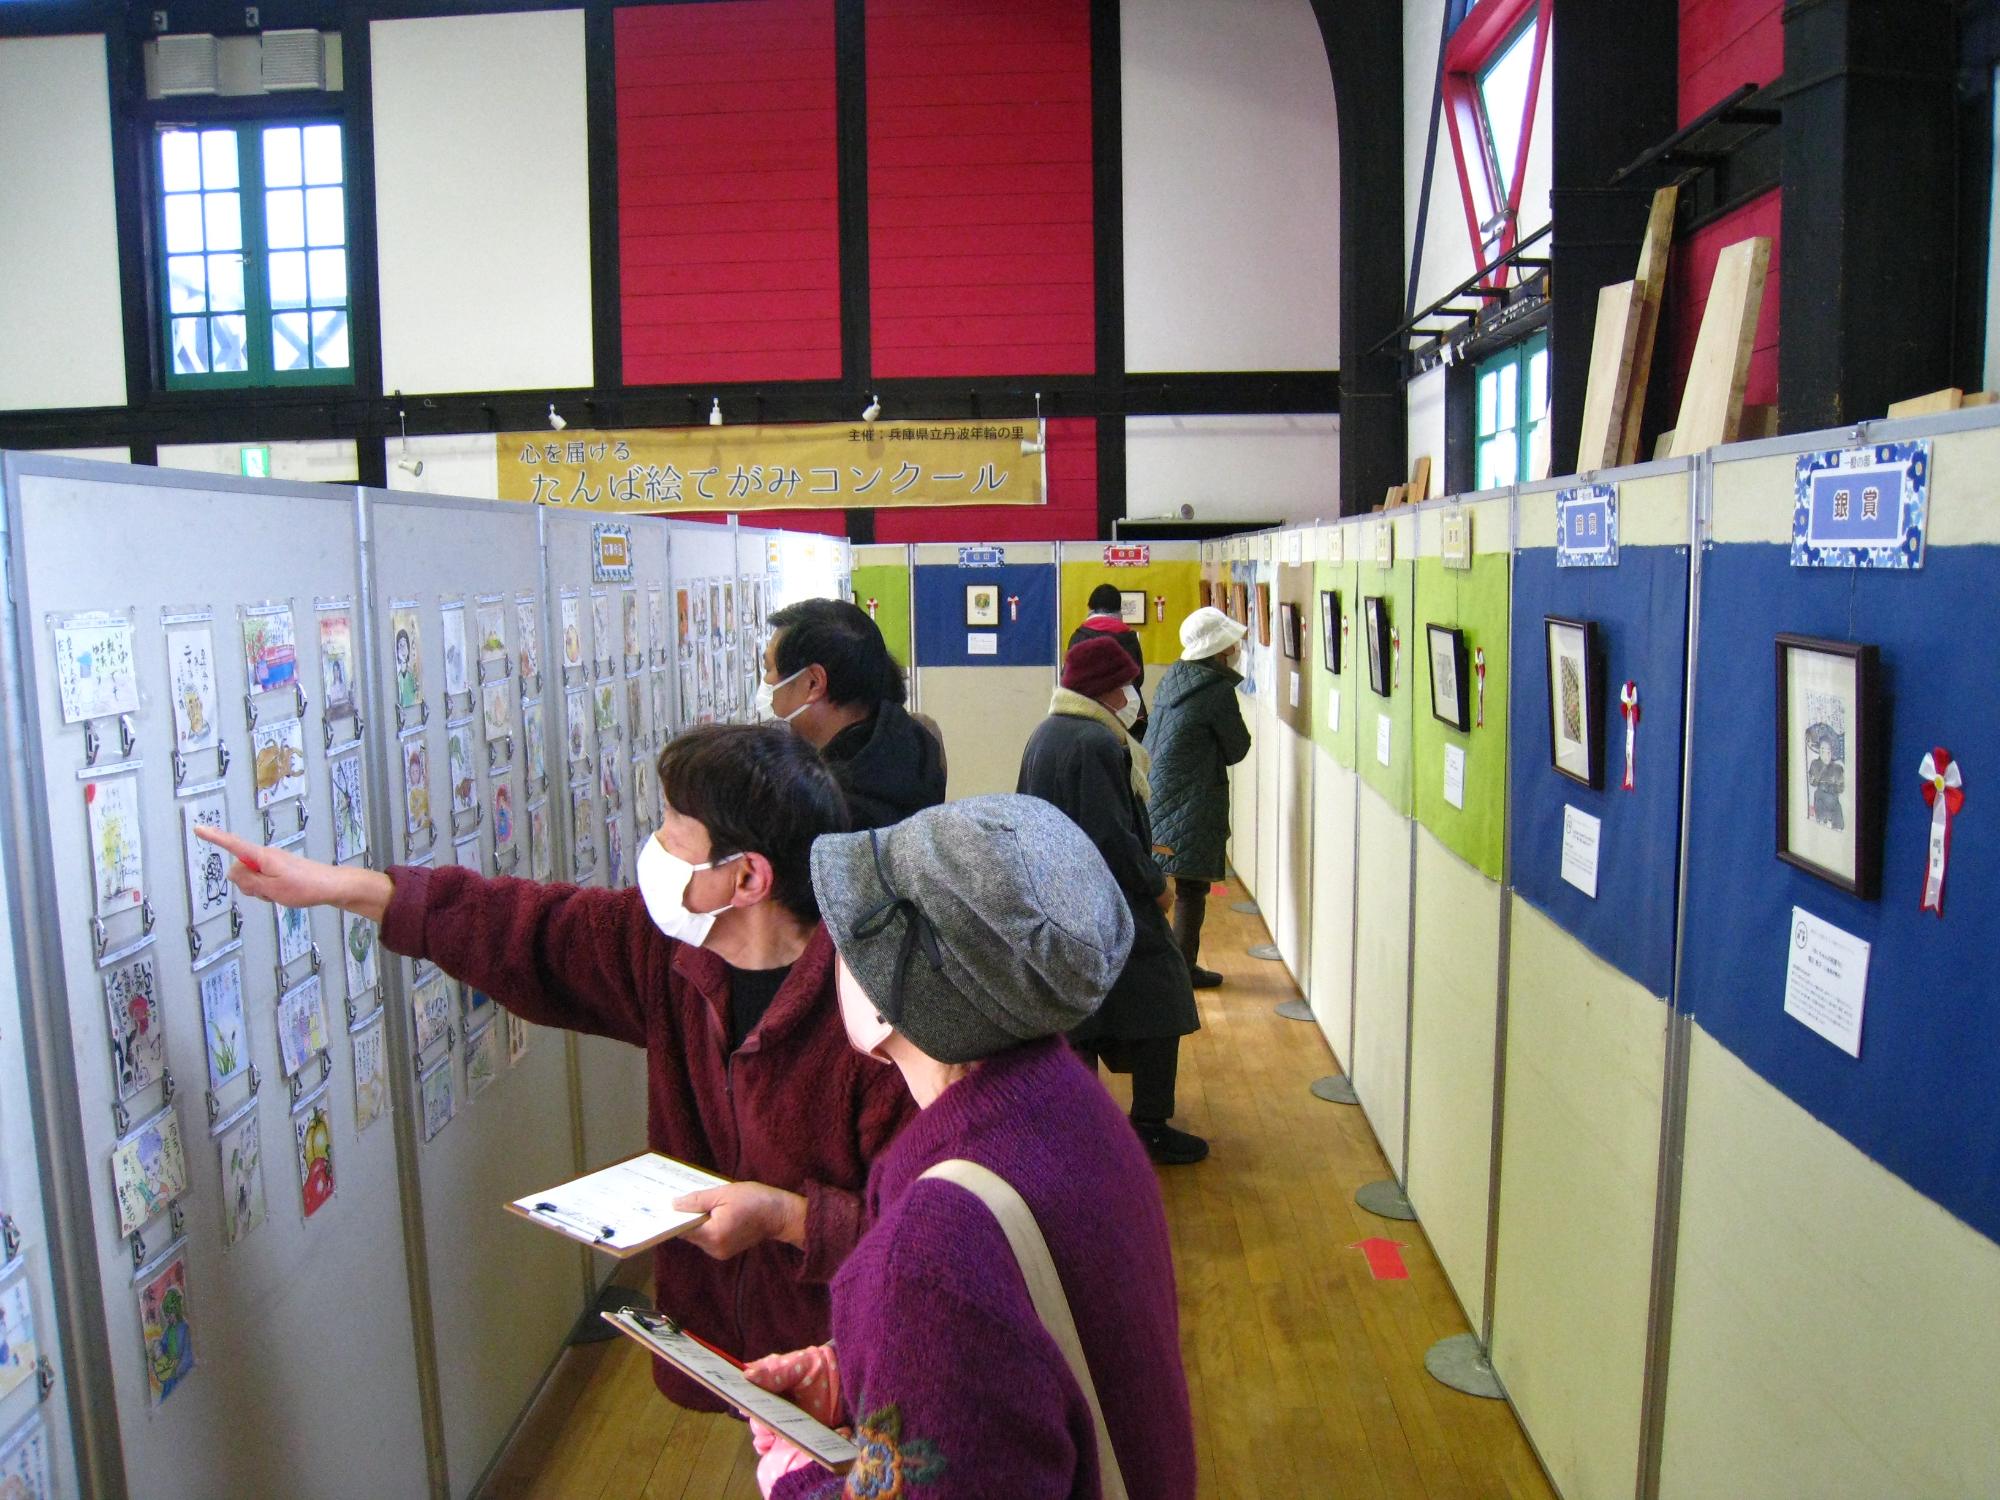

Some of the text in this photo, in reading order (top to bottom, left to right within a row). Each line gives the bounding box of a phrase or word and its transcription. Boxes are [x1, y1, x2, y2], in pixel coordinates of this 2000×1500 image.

[848, 426, 1025, 443] 主催：兵庫県立丹波年輪の里
[520, 441, 631, 464] 心を届ける
[531, 460, 1008, 504] たんば絵てがみコンクール
[1834, 488, 1879, 519] 銀賞
